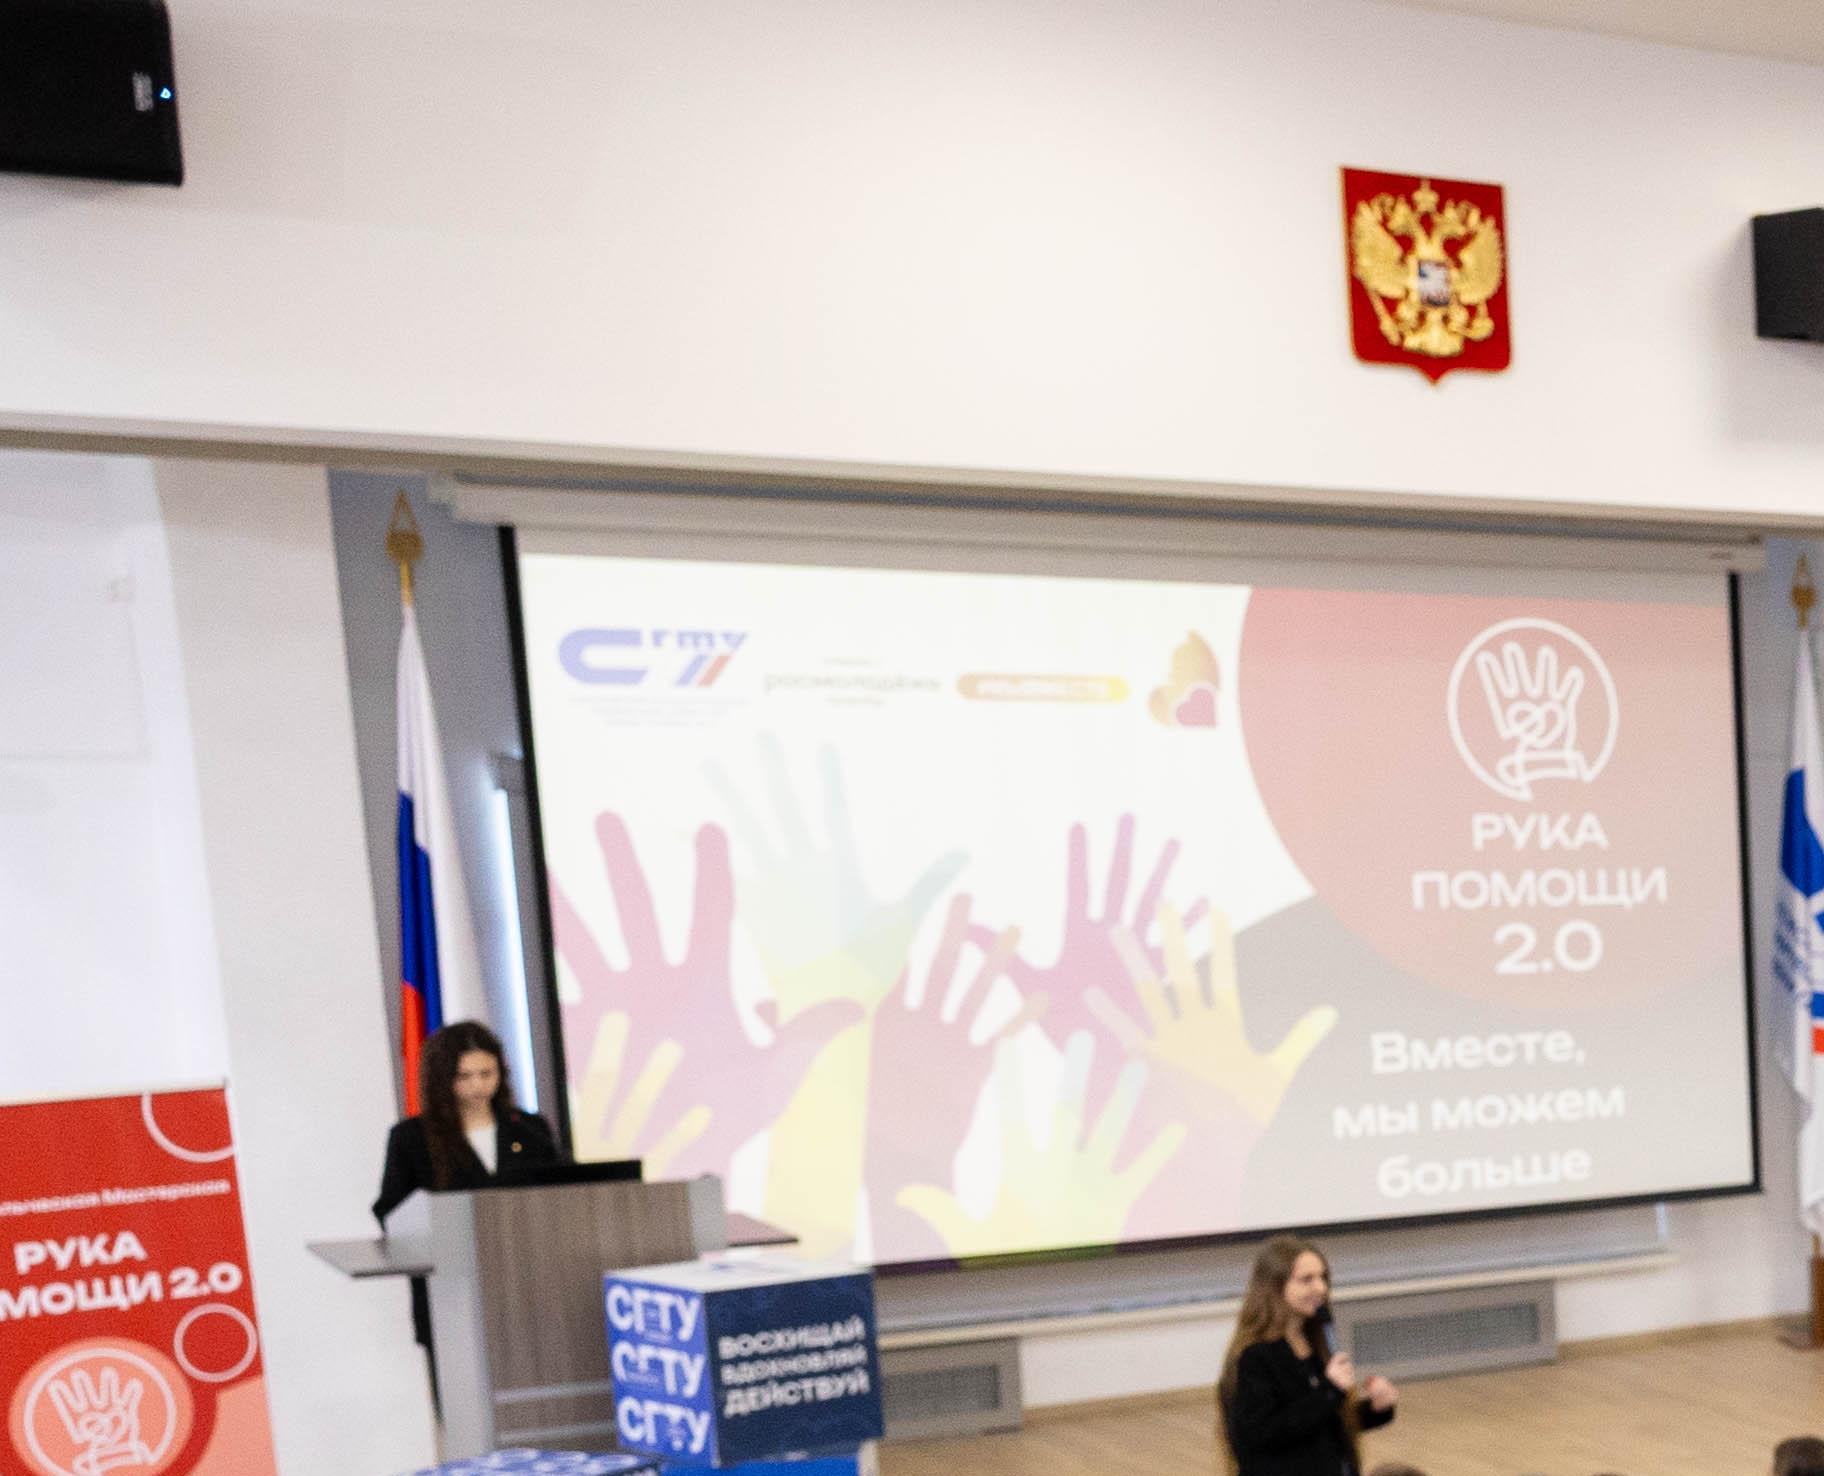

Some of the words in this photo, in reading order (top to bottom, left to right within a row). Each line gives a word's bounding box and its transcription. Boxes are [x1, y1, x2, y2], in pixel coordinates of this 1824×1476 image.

[1471, 813, 1608, 850] РУКА
[1412, 868, 1668, 911] ПОМОЩИ
[1493, 920, 1603, 974] 2.0
[1371, 1028, 1586, 1076] Вместе,
[1332, 1104, 1419, 1139] мы
[1432, 1085, 1626, 1133] можем
[1376, 1147, 1592, 1198] больше
[14, 1231, 148, 1275] РУКА
[169, 1261, 243, 1300] 2.0
[606, 1286, 700, 1341] СГТУ
[612, 1341, 706, 1399] СГТУ
[724, 1369, 870, 1418] ДЕЙСТВУЙ
[617, 1397, 711, 1454] СГТУ
